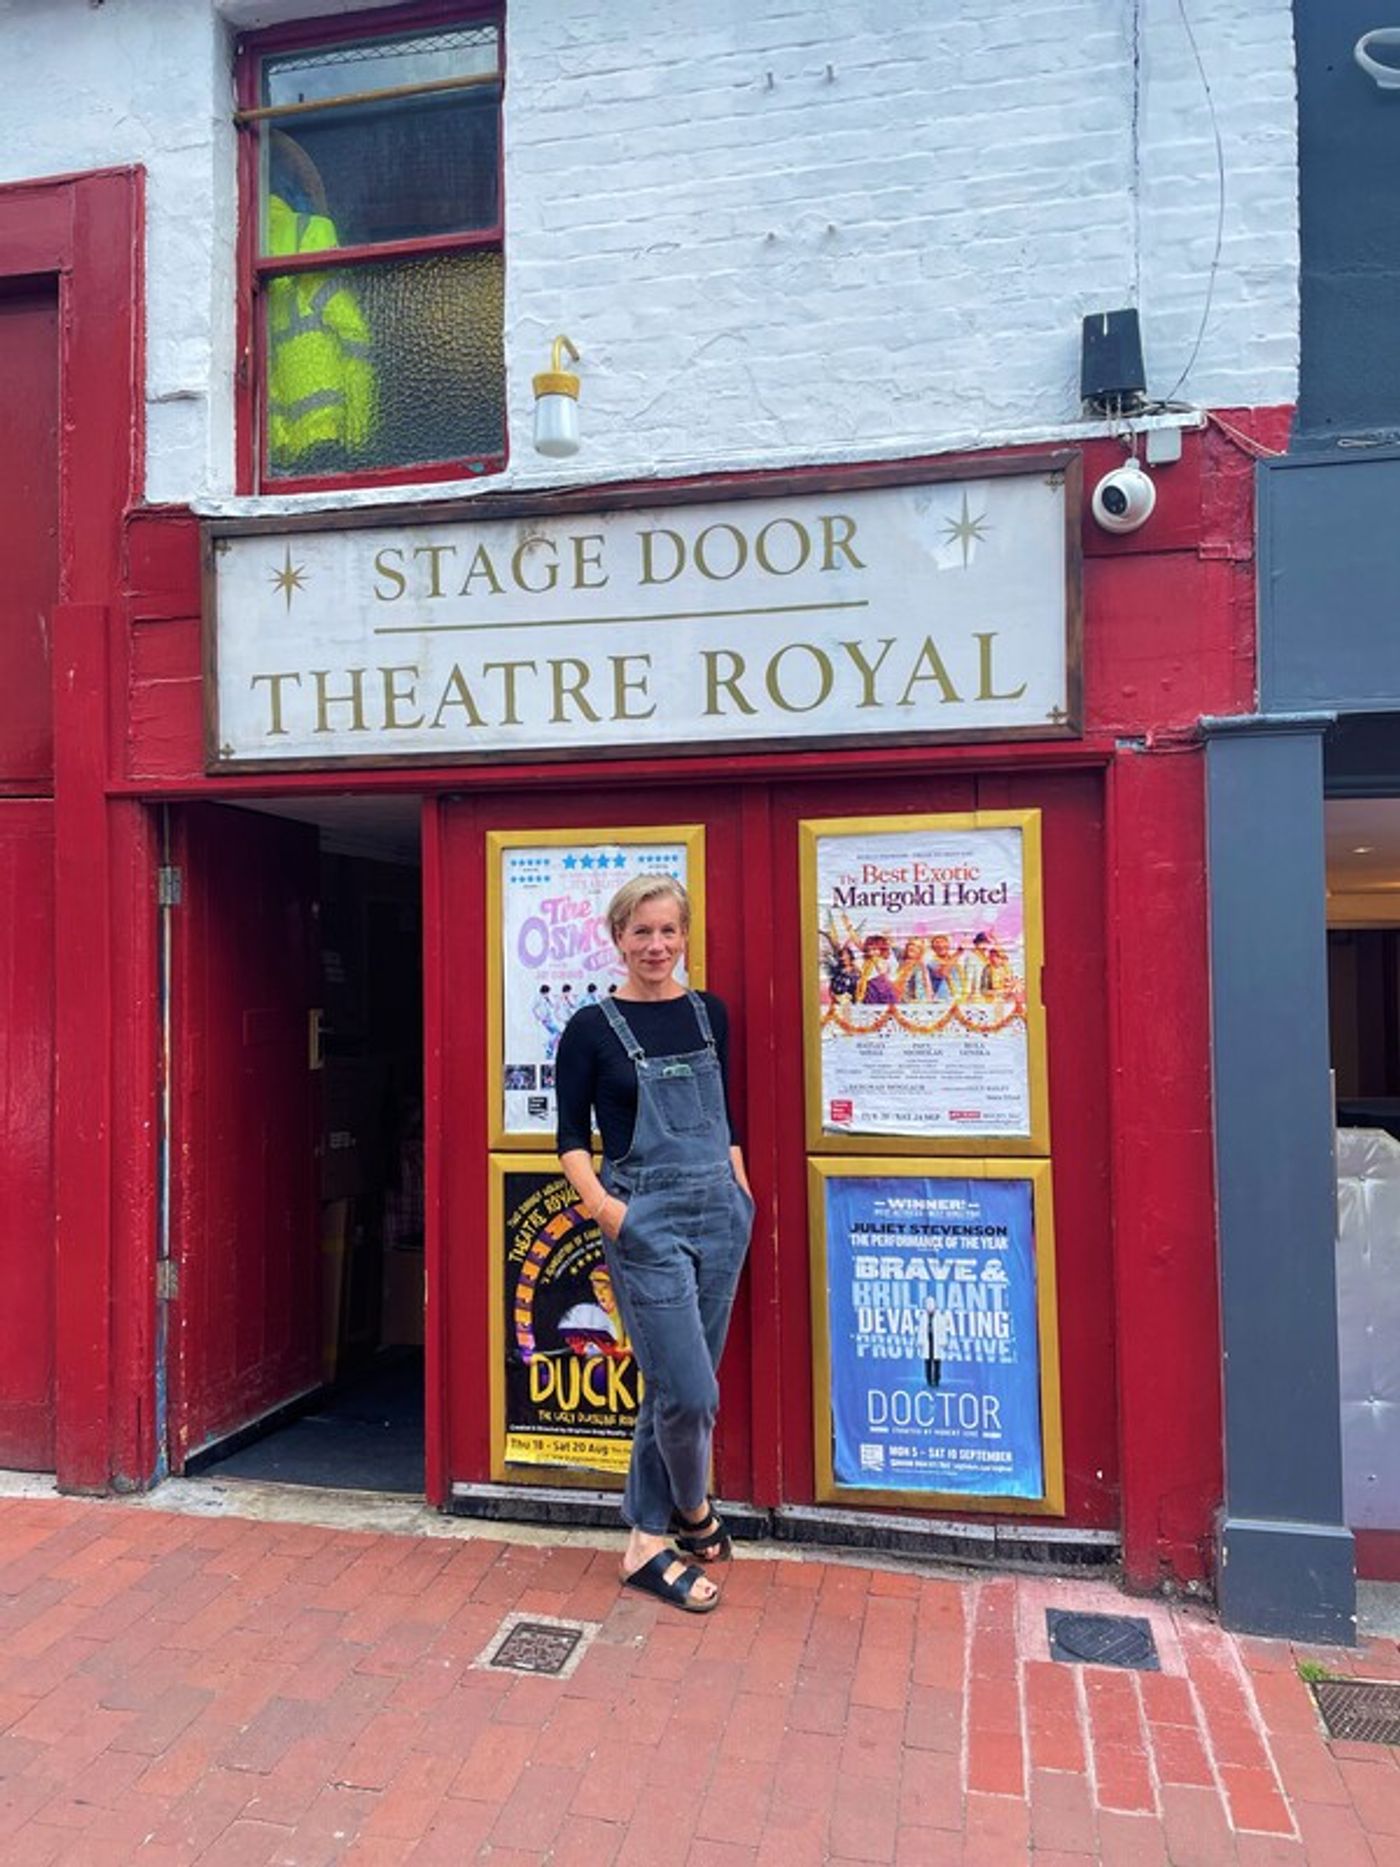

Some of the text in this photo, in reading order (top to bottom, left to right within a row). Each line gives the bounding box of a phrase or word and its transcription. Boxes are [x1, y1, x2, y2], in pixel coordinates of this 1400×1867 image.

[373, 514, 867, 602] STAGE DOOR
[250, 631, 1028, 736] THEATRE ROYAL
[861, 863, 907, 885] Best
[913, 861, 980, 883] Exotic
[831, 881, 1008, 914] Marigold Hotel
[540, 895, 592, 925] The
[887, 1198, 967, 1210] WINNER!
[850, 1222, 1008, 1236] JULIET STEVENSON
[850, 1234, 1009, 1250] THE PERFORMANCE OF THE YEAR
[980, 1258, 1007, 1282] &
[867, 1389, 1002, 1430] DOCTOR
[511, 1438, 530, 1450] Thu
[553, 1441, 570, 1453] Sat
[572, 1441, 587, 1453] 20
[588, 1443, 608, 1456] Aug
[889, 1445, 909, 1457] MON
[912, 1446, 918, 1457] 5
[928, 1447, 945, 1459] SAT
[947, 1448, 957, 1460] 10
[959, 1449, 1012, 1462] SEPTEMBER
